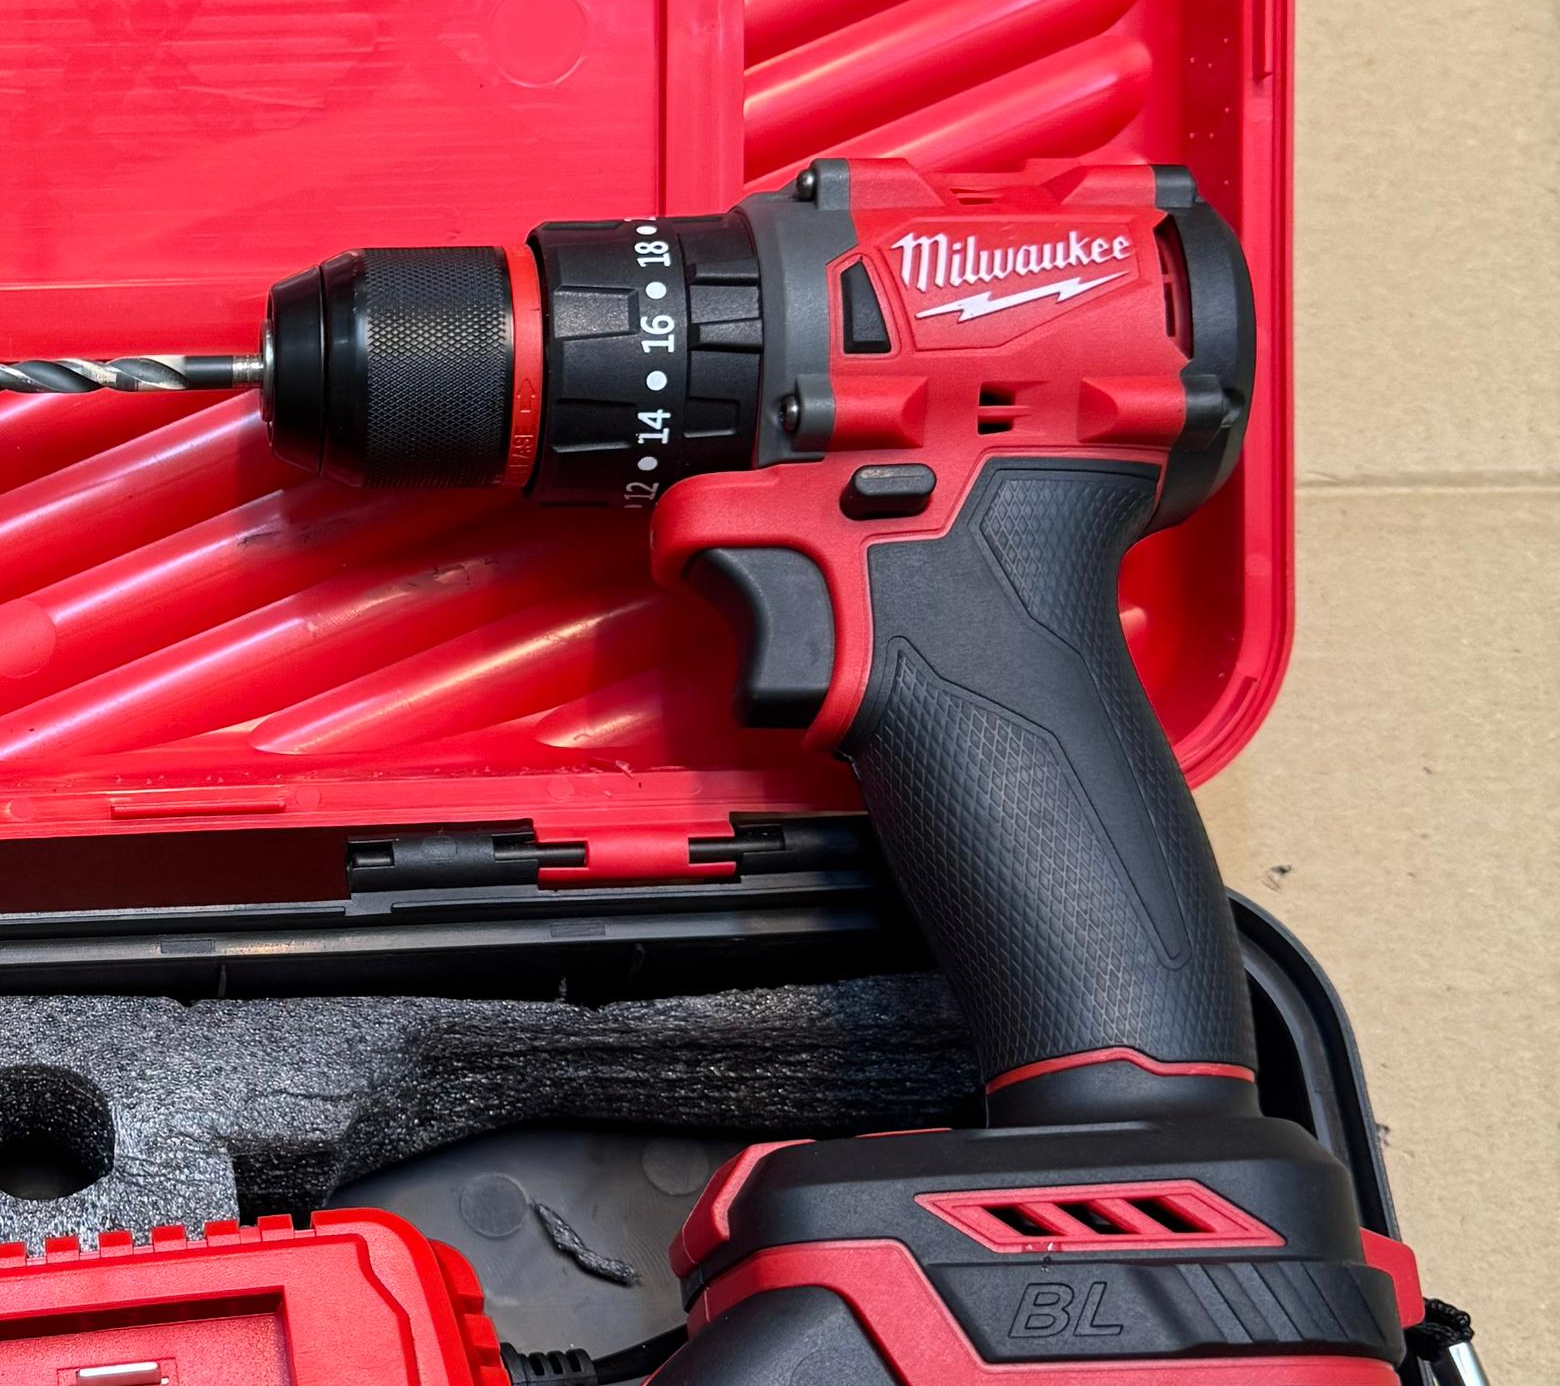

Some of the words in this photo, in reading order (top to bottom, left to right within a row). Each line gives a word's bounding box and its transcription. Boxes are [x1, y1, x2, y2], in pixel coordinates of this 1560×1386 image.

[634, 240, 672, 268] 18
[890, 230, 1133, 293] Milwaukee
[640, 314, 676, 354] 16
[635, 409, 672, 445] 14
[623, 481, 660, 501] 12
[1007, 1281, 1124, 1339] BL
